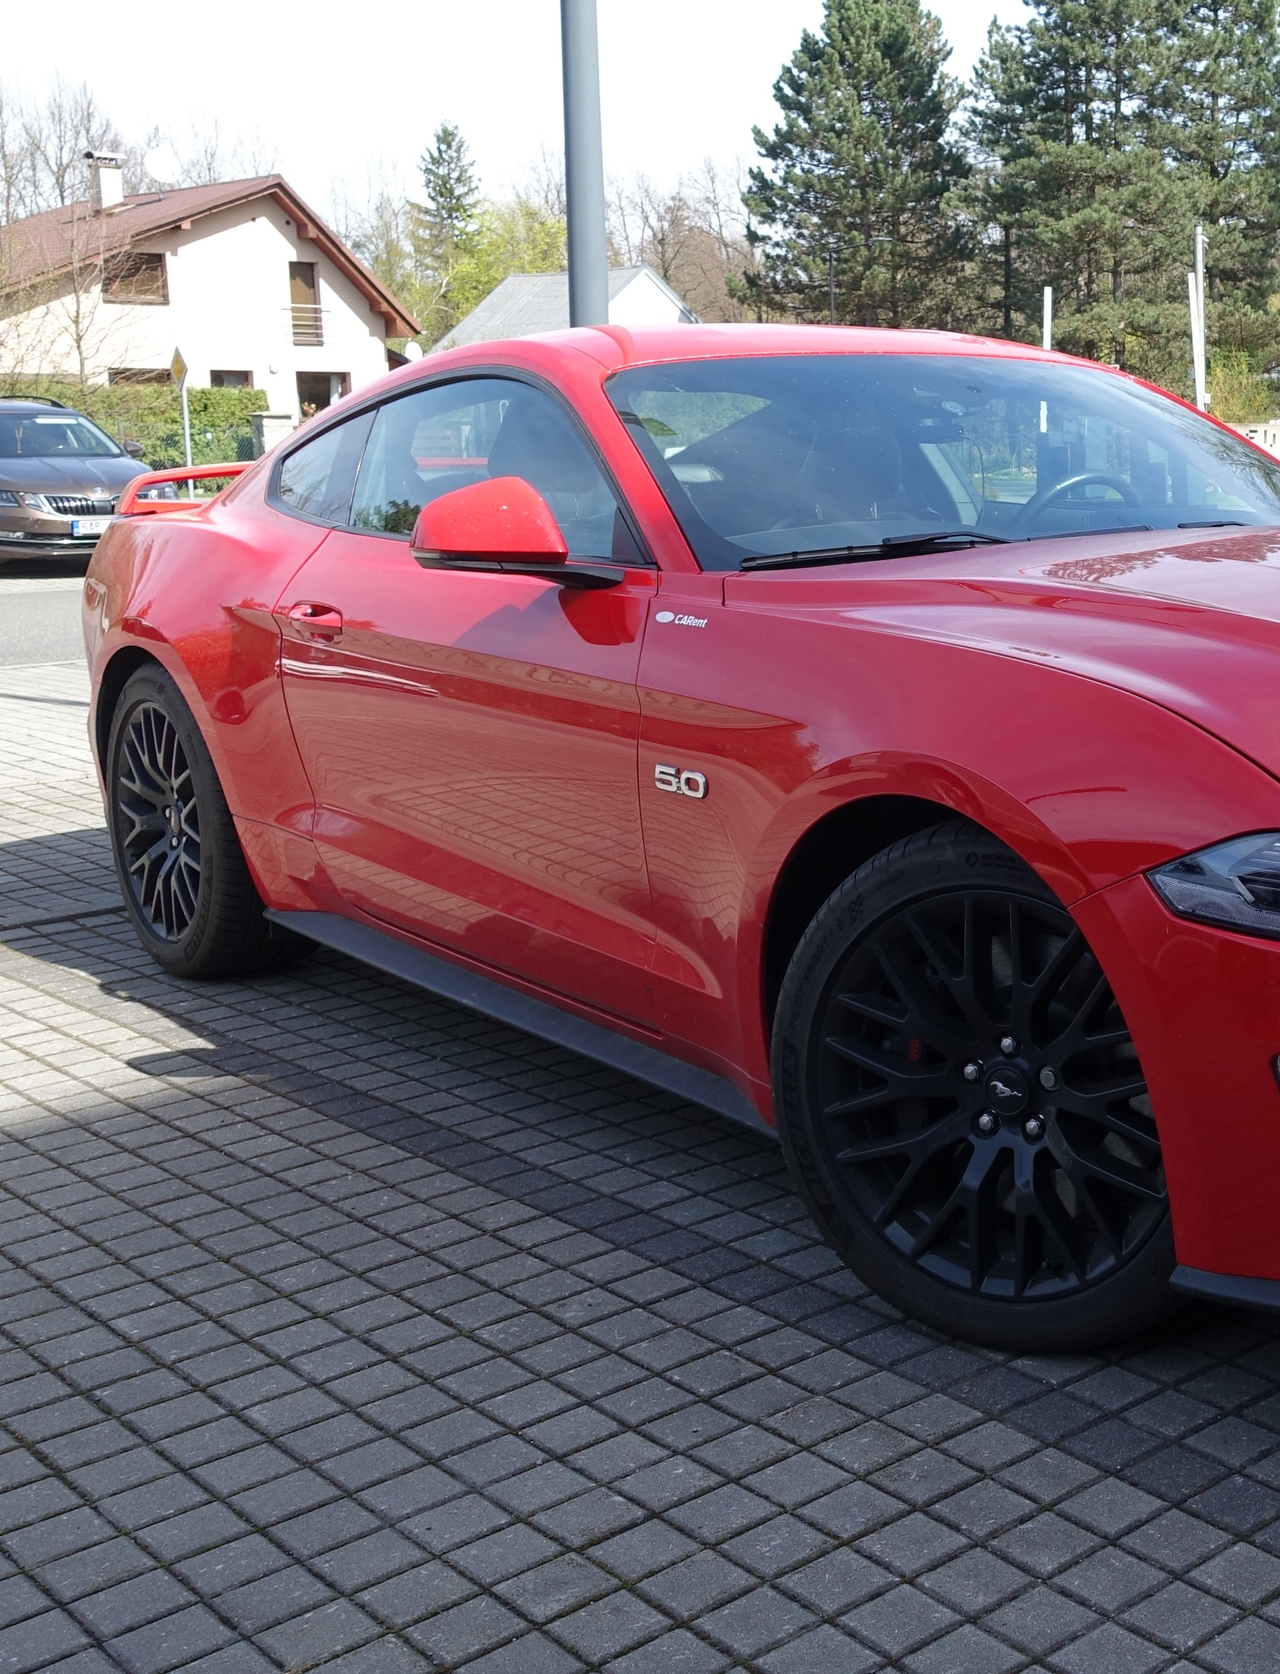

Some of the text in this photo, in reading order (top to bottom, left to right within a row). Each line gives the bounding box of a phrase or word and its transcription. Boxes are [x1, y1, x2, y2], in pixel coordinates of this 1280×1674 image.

[674, 614, 708, 628] CARent
[655, 763, 708, 799] 5.0
[789, 984, 806, 1031] PILOT
[803, 935, 829, 985] SPORT
